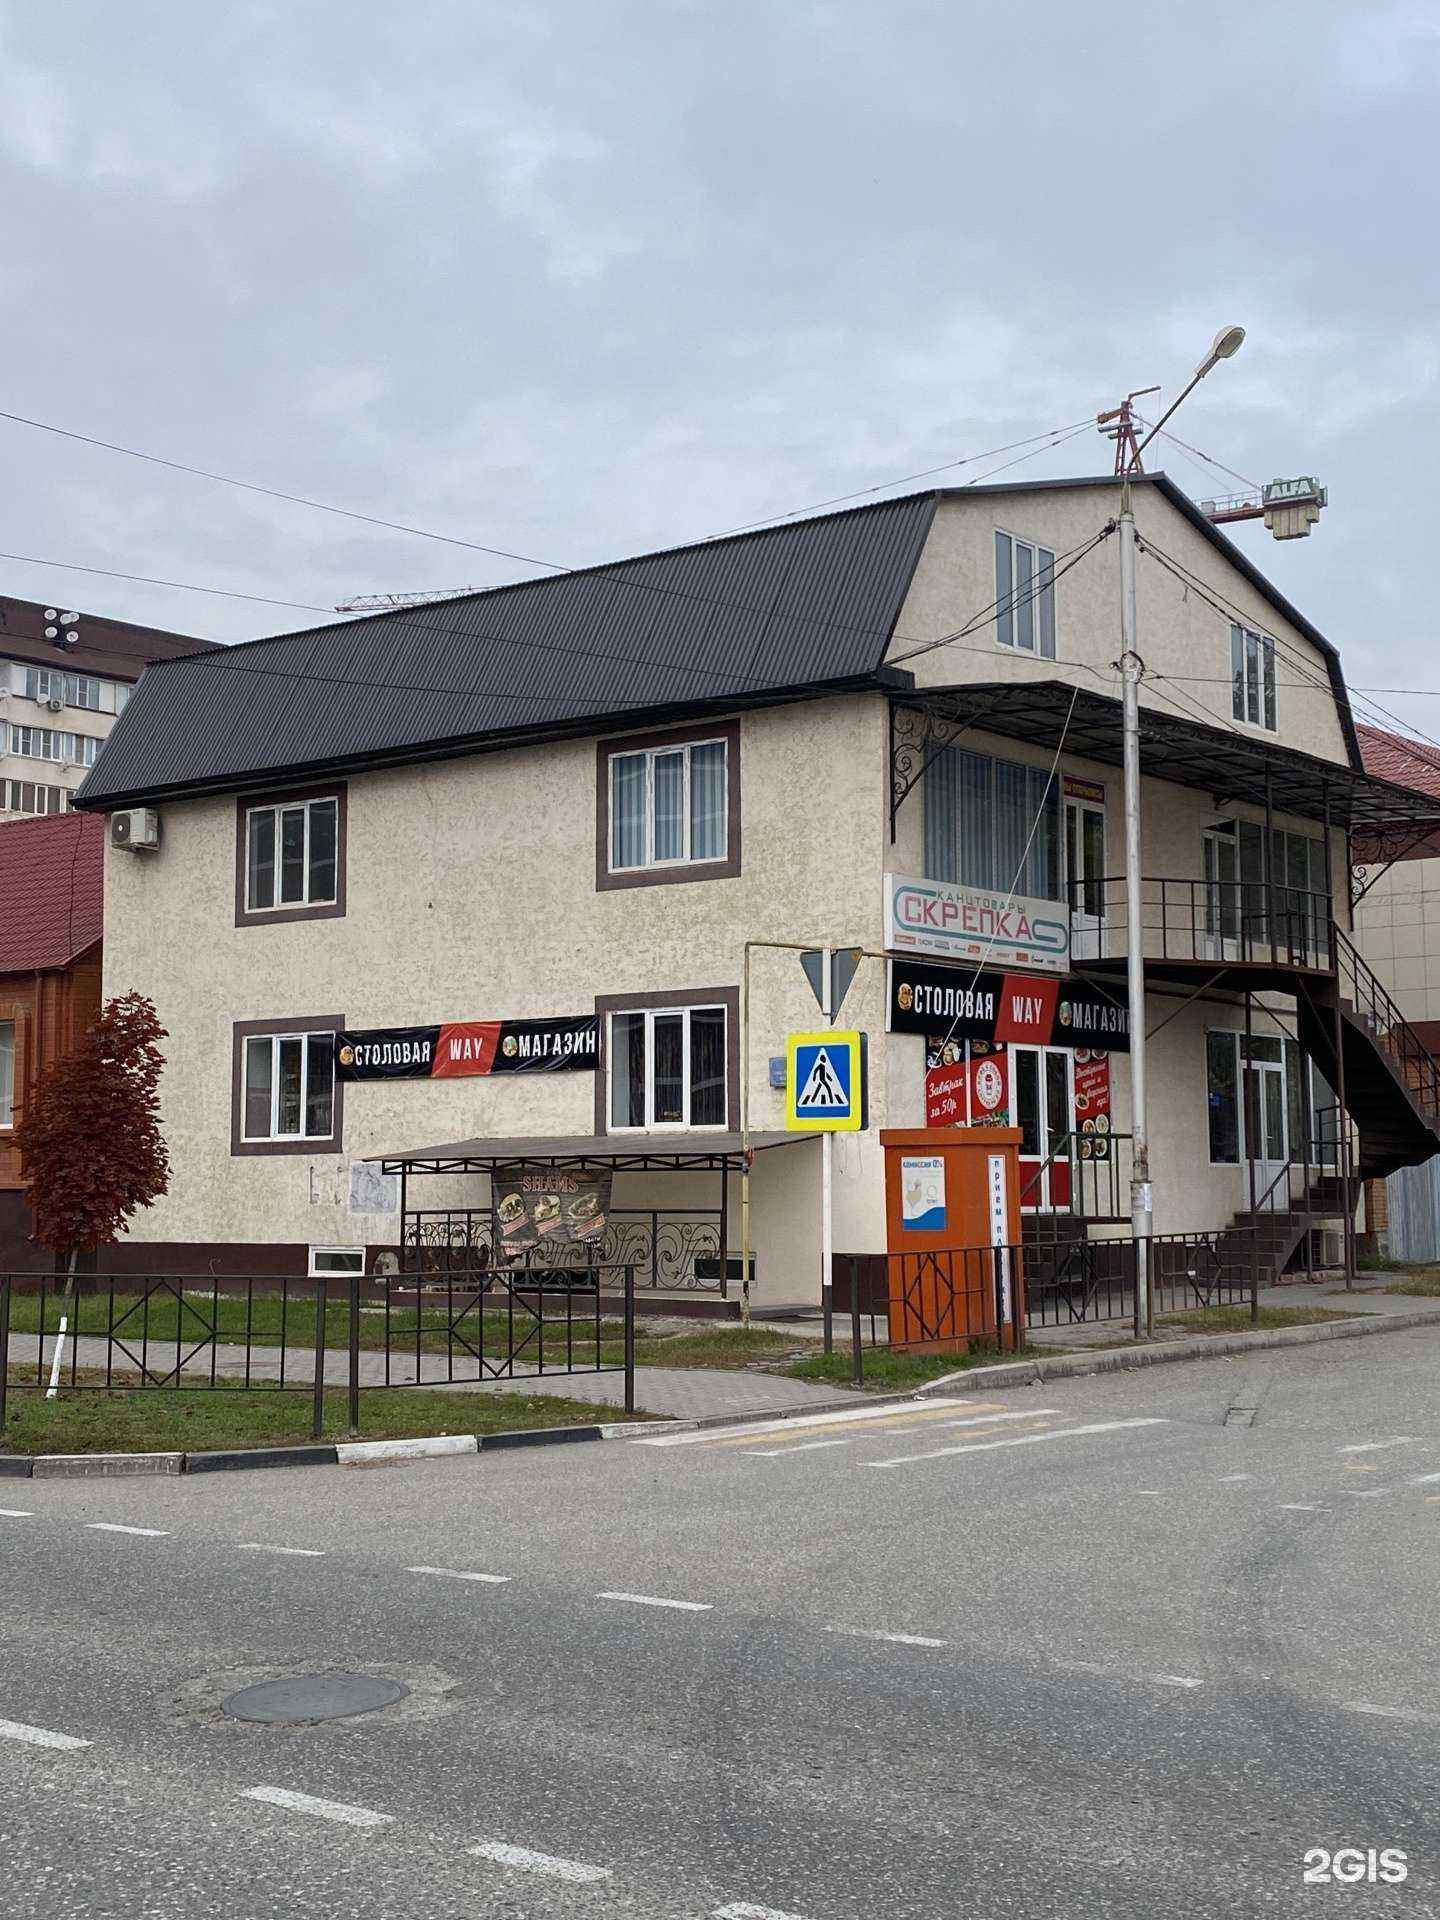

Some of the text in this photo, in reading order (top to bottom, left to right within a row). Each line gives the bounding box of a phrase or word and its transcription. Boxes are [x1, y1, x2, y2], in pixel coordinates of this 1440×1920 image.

[903, 895, 1033, 941] СКРЕПКА
[936, 888, 1026, 913] КАНЦТОВАРЫ
[914, 984, 994, 1021] СТОЛОВАЯ
[1012, 995, 1043, 1025] WAY
[354, 1030, 596, 1066] СТОЛОВАЯ WAY МАГАЗИН
[928, 1076, 965, 1099] Завтрак
